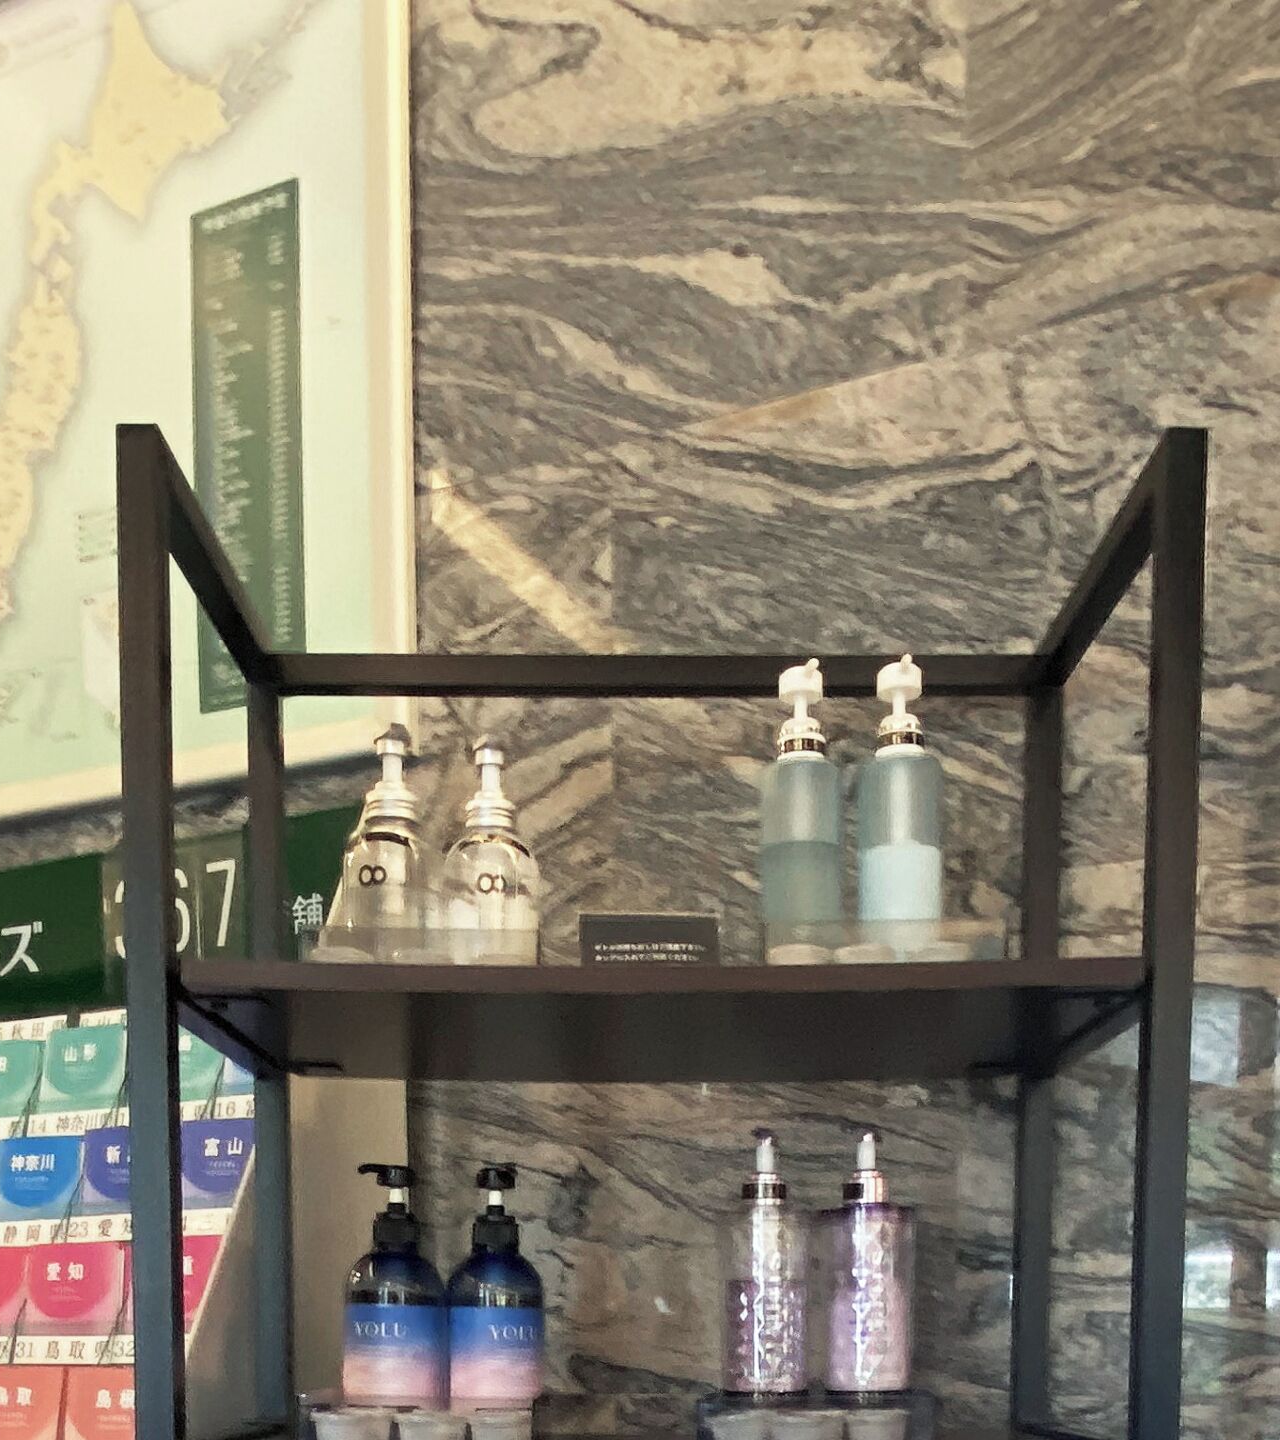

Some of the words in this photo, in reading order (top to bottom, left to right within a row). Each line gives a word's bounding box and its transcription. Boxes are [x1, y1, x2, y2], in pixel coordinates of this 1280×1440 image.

[217, 1101, 236, 1117] 16
[31, 1119, 47, 1134] 14
[106, 1145, 131, 1164] 新
[205, 1137, 243, 1157] 富山
[10, 1153, 56, 1172] 神奈川
[70, 1221, 89, 1238] 23
[46, 1262, 85, 1282] 愛知
[16, 1341, 34, 1358] 31
